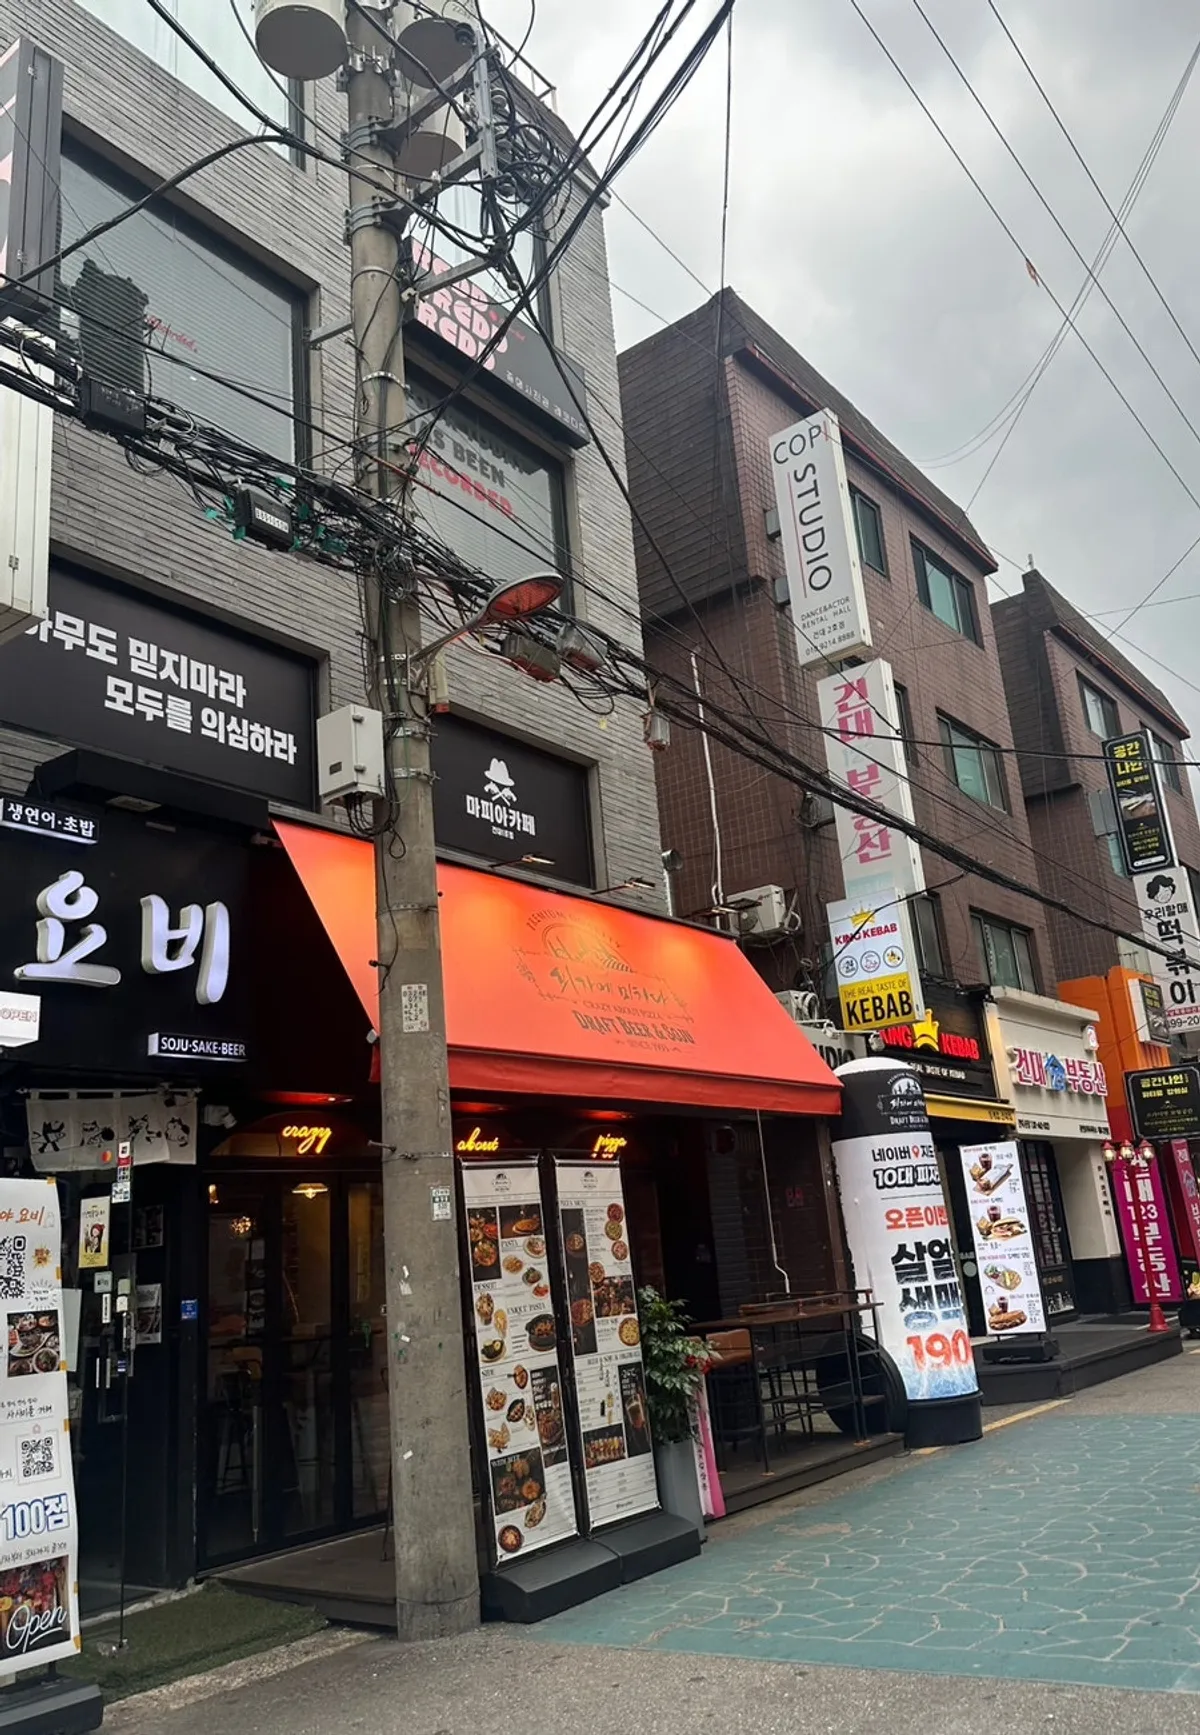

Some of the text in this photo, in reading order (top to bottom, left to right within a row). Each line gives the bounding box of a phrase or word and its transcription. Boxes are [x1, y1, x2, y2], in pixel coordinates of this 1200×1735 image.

[773, 424, 821, 464] COP
[452, 450, 506, 489] BEEN
[794, 461, 832, 592] STUDIO
[801, 596, 850, 621] DANCE&ACTOR
[802, 604, 851, 629] RENTAL HALL
[128, 637, 247, 708] 믿지마라
[104, 675, 298, 765] 모두를 의심하라
[833, 677, 874, 742] 건대
[8, 802, 96, 837] 생연어·초밥
[466, 795, 536, 836] 마피아카페
[846, 763, 892, 865] 부산
[14, 870, 229, 1005] 요비
[835, 922, 898, 946] KING KEBAB
[844, 978, 907, 999] THE REAL TASTE OF
[1, 1007, 37, 1023] OPEN
[846, 991, 913, 1026] KEBAB
[572, 1010, 619, 1036] DRAFT
[617, 1016, 654, 1040] BEER
[663, 1026, 696, 1044] SOJU
[880, 1024, 980, 1061] KING KEBAB
[161, 1037, 246, 1057] SOJU·SAKE·BEER
[1014, 1048, 1108, 1097] 건대 부동산
[283, 1124, 628, 1159] crazy about pizza
[872, 1145, 912, 1162] 네이버
[873, 1164, 915, 1189] 10대
[17, 1205, 46, 1227] 요비
[1, 1493, 70, 1541] 100점
[6, 1605, 68, 1653] Open
